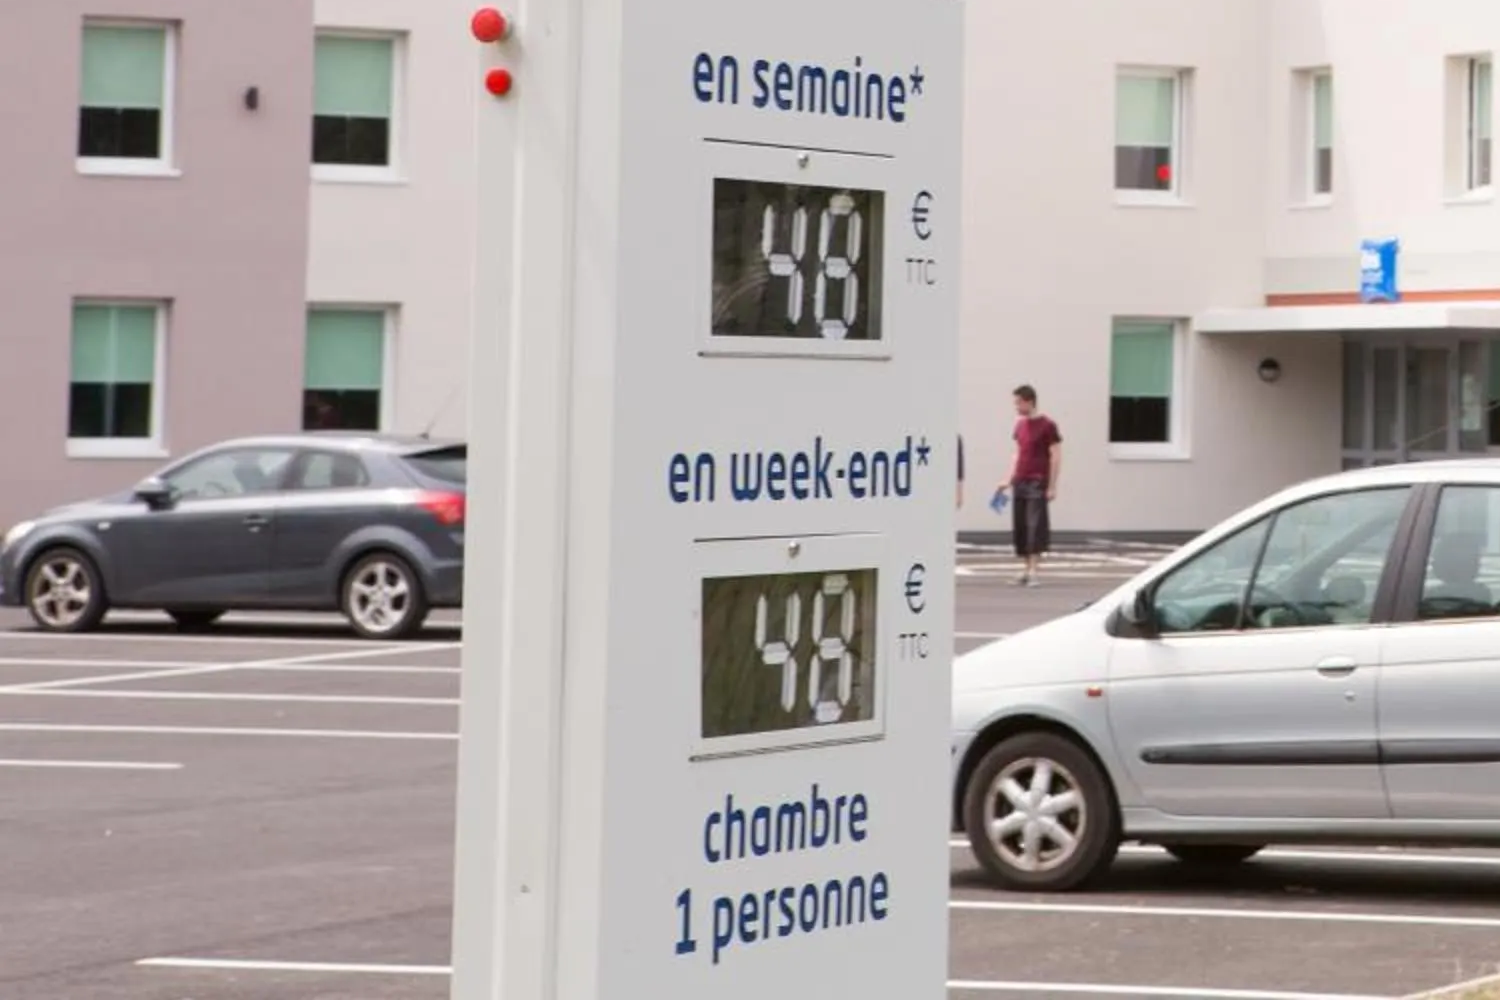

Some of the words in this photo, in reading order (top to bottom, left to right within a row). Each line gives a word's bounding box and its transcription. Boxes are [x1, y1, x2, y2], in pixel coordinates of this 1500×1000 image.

[693, 52, 738, 104] en
[911, 189, 932, 240] €
[762, 193, 862, 338] 48
[905, 258, 936, 285] TTC
[668, 451, 716, 502] en
[904, 563, 926, 615] €
[755, 573, 855, 724] 48
[897, 631, 929, 660] TTC
[704, 782, 868, 863] chambre
[674, 887, 697, 955] 1
[711, 871, 889, 964] personne
